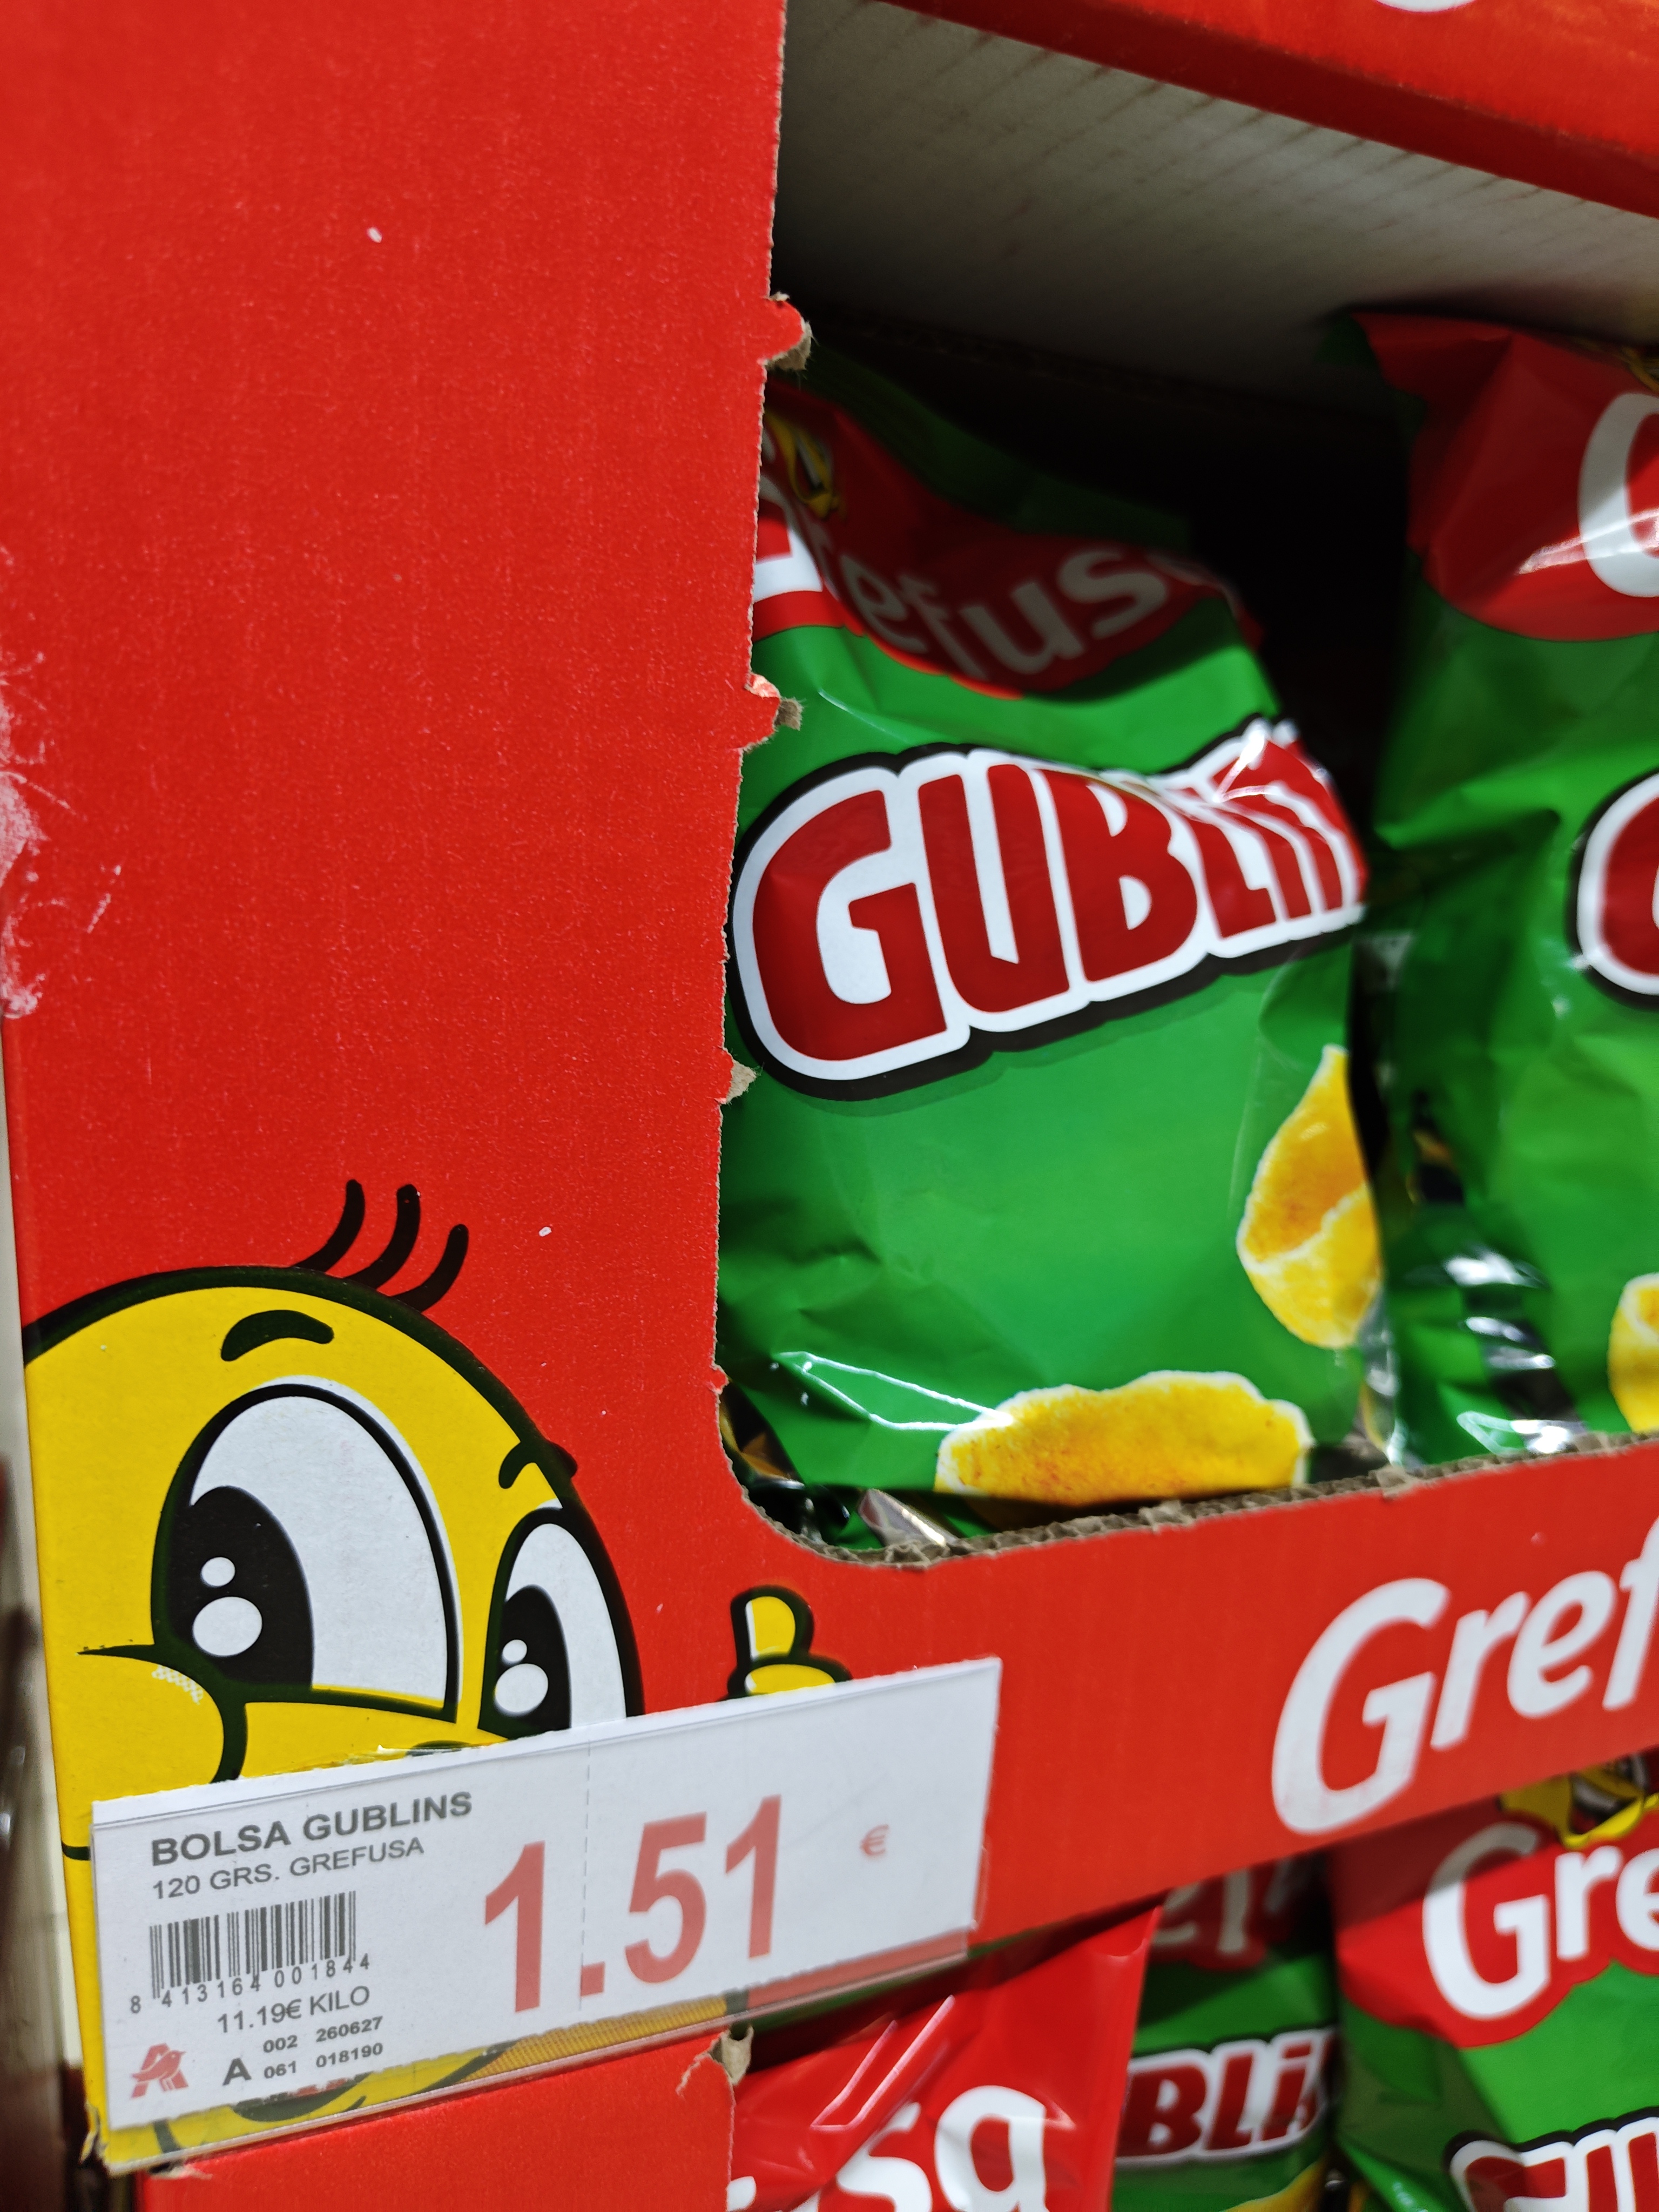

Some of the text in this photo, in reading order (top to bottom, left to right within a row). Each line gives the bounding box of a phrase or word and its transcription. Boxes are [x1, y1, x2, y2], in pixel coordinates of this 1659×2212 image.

[151, 1792, 472, 1866] BOLSA GUBLINS
[153, 1836, 426, 1899] 120 GRS. GREFUSA
[484, 1793, 890, 2014] 1.51 €
[217, 1985, 370, 2034] 11.19€ KILO
[262, 2015, 383, 2053] 002 260627
[222, 2058, 252, 2086] A
[264, 2060, 298, 2079] 061
